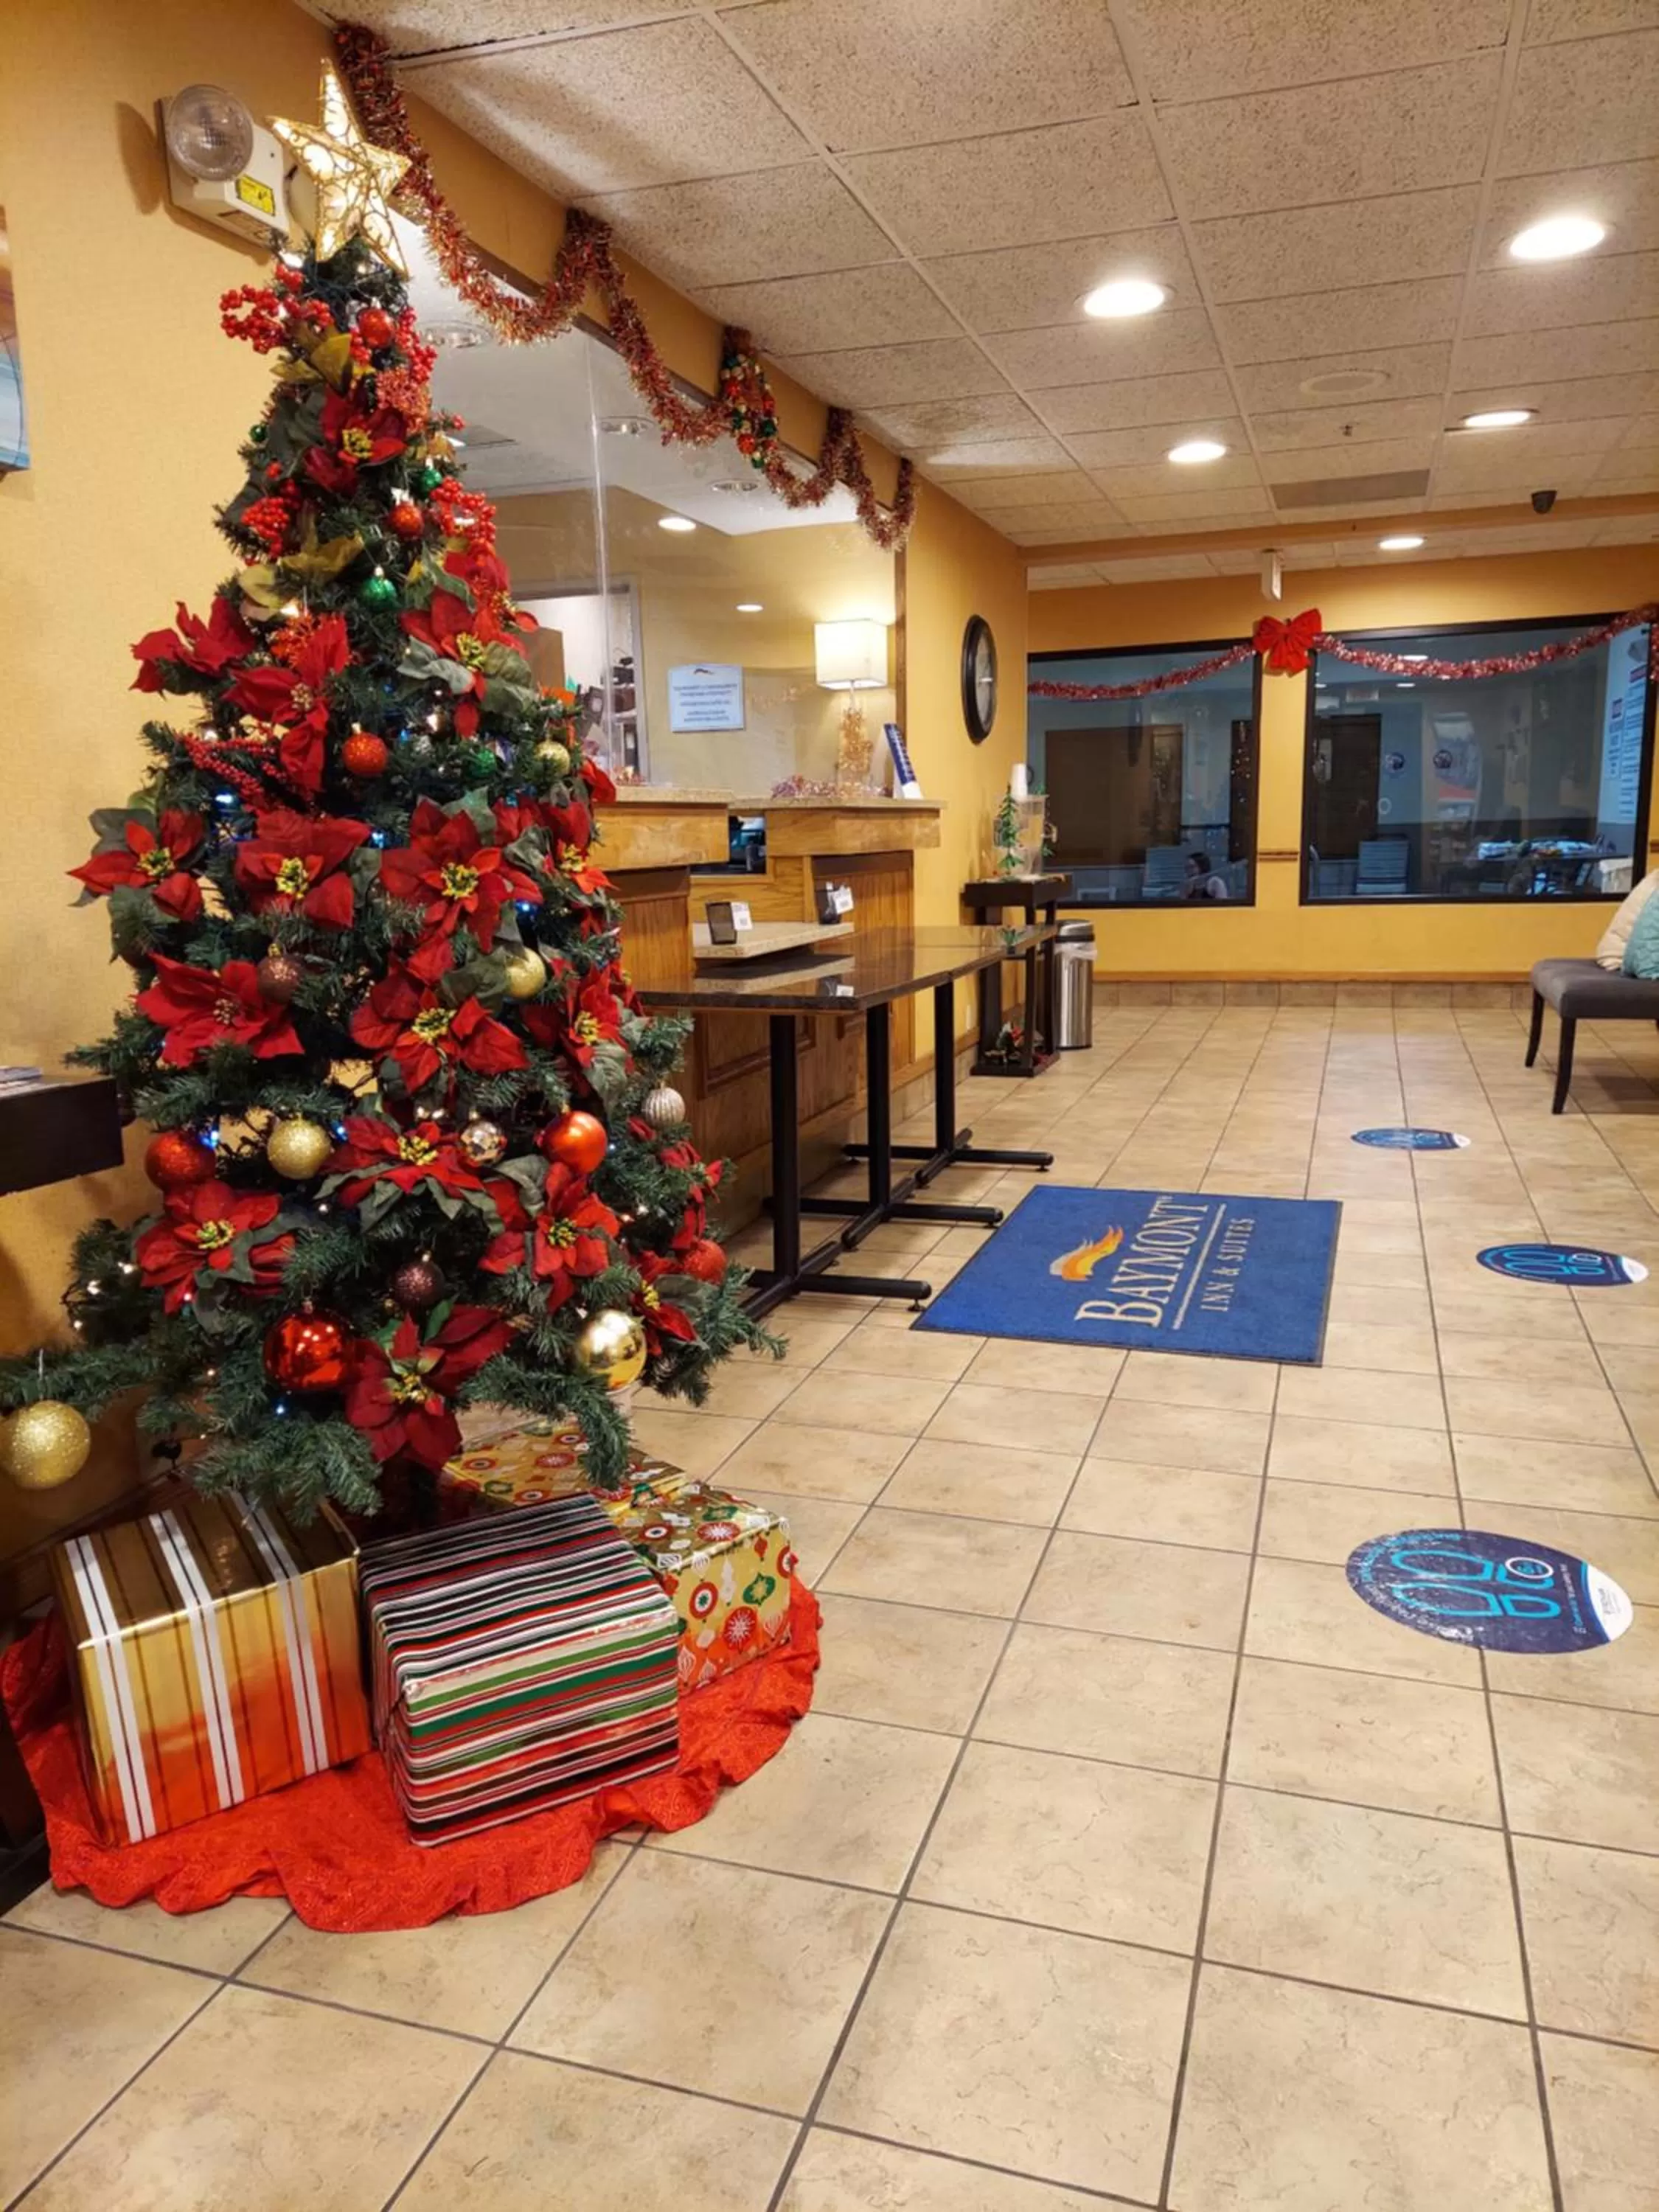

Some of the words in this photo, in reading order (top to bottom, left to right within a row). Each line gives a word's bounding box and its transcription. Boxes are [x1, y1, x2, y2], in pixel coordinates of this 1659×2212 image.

[1217, 1218, 1256, 1262] SUITES
[1074, 1198, 1210, 1329] BAYMONT
[1212, 1265, 1242, 1277] &
[1200, 1281, 1235, 1312] INN
